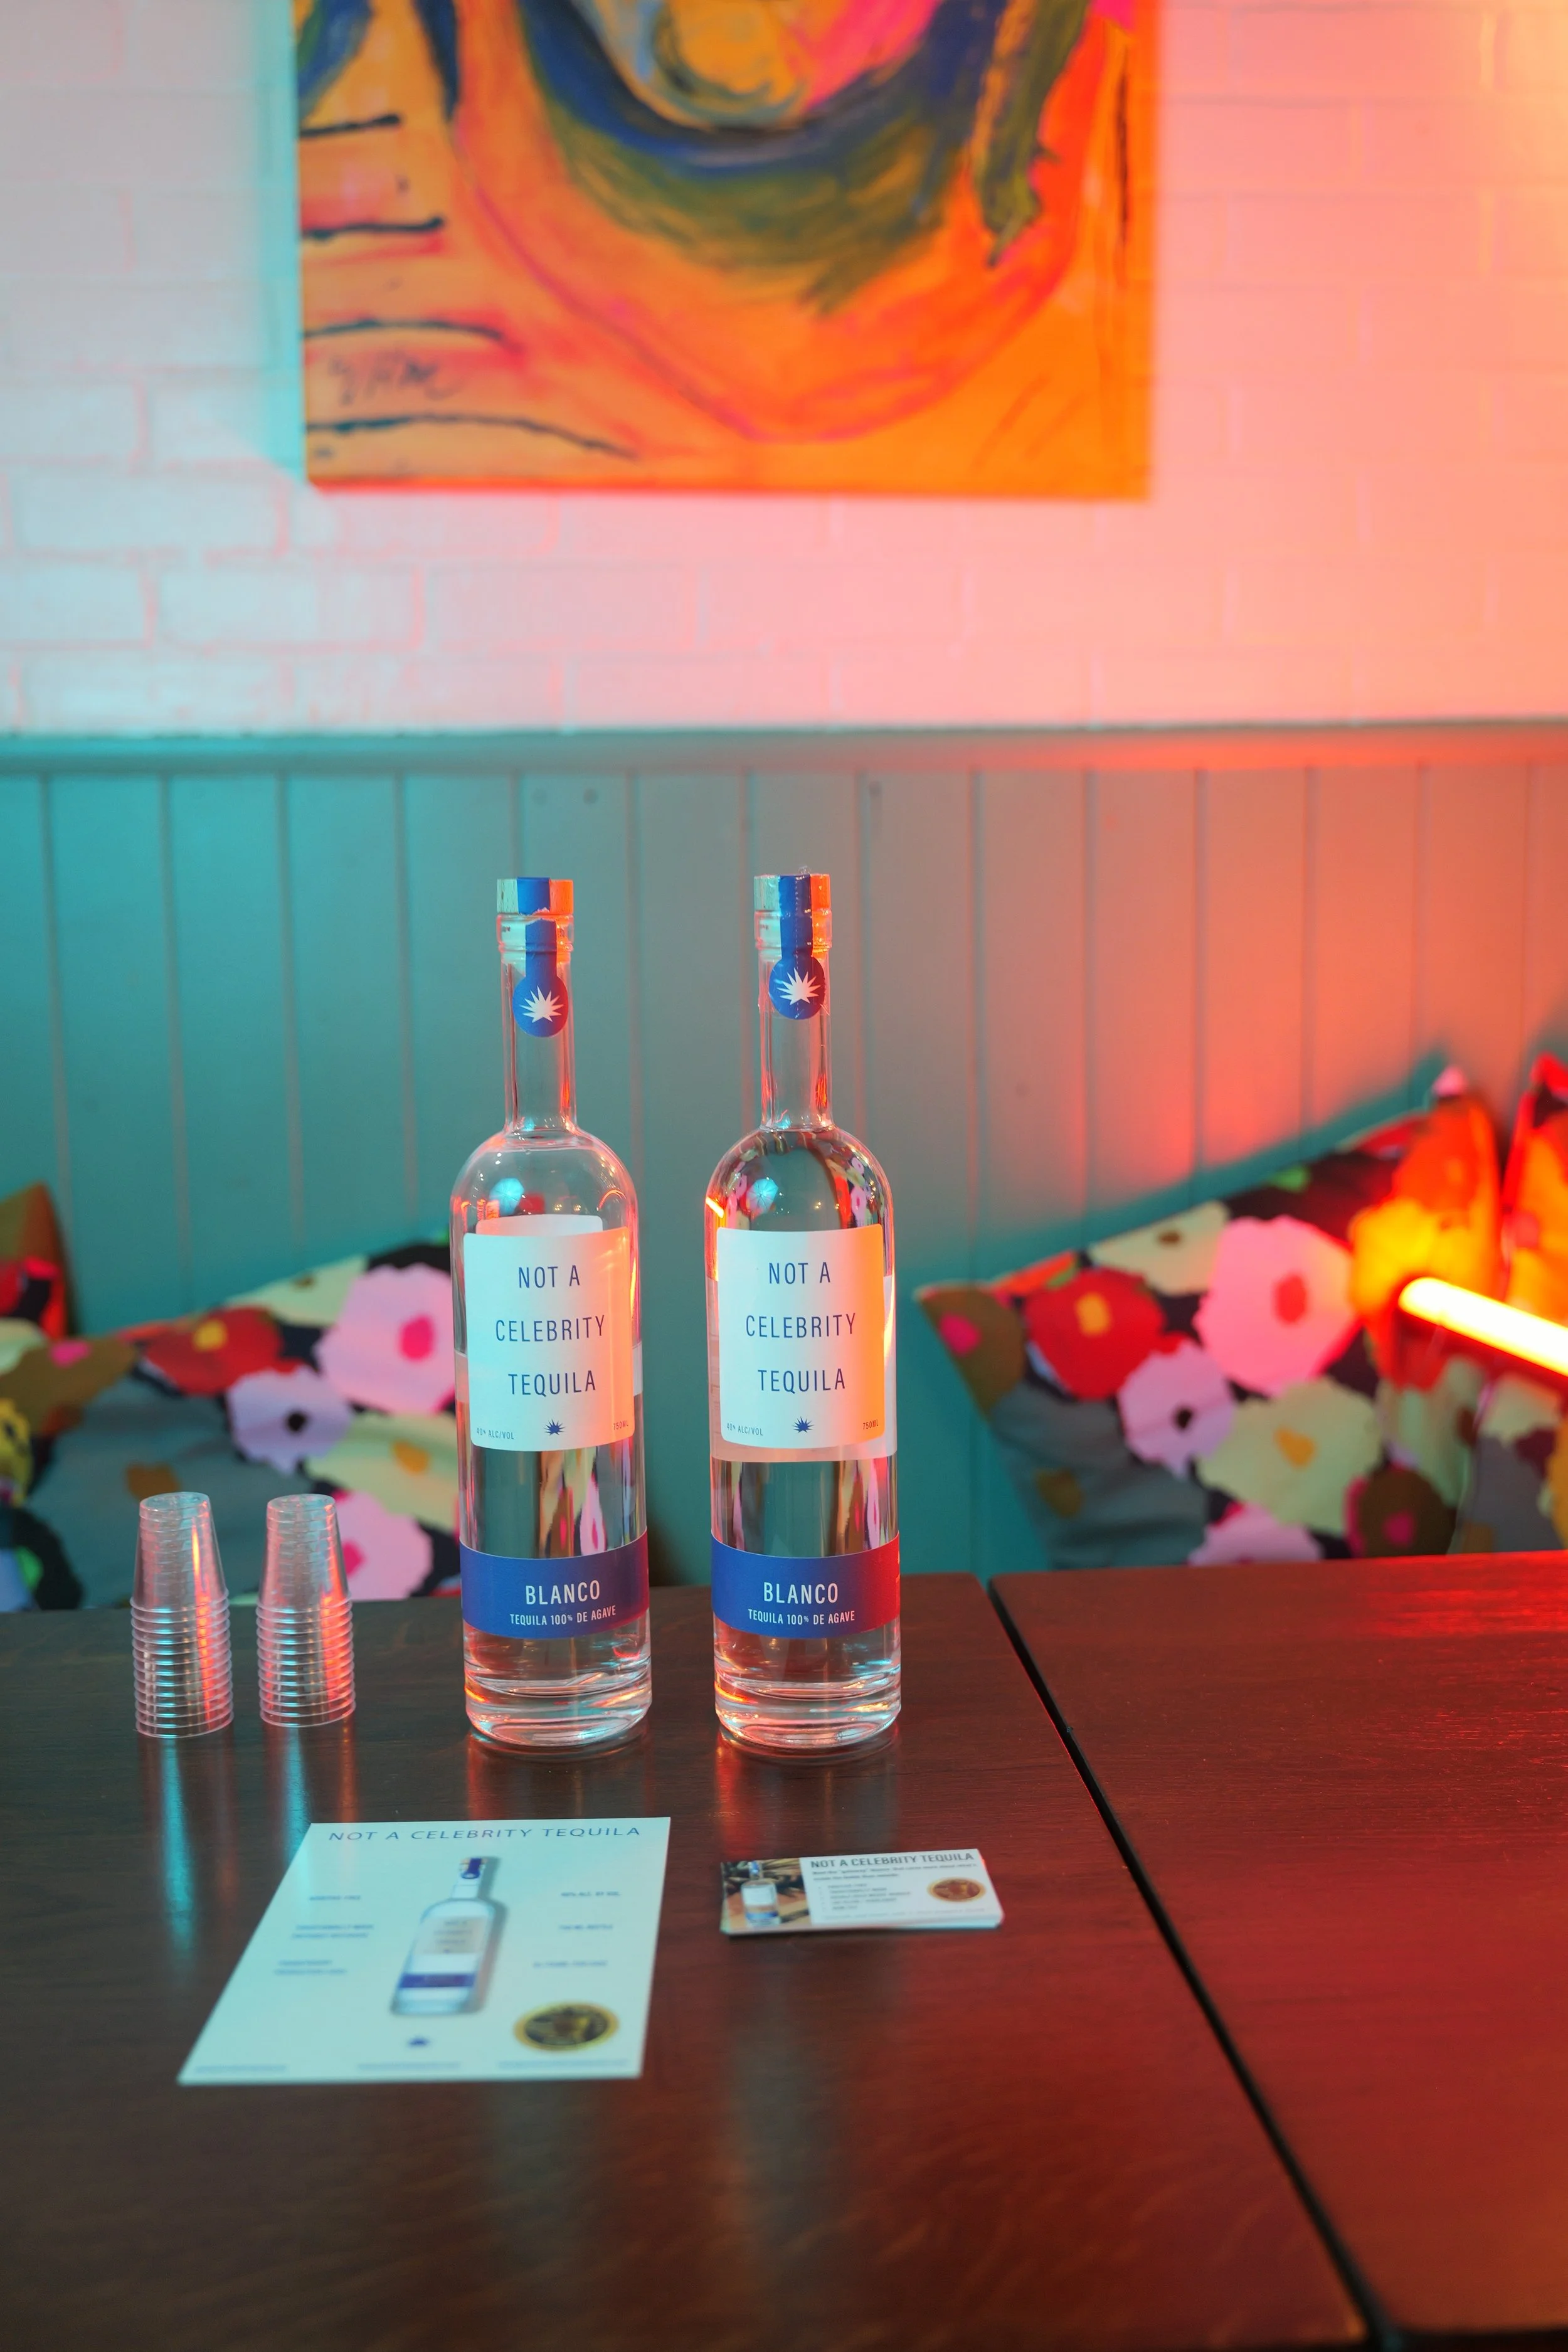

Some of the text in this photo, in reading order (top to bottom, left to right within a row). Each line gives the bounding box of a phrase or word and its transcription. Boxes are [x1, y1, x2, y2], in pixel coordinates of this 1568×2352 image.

[519, 1264, 581, 1288] NOT A
[768, 1261, 831, 1285] NOT A
[495, 1315, 605, 1342] CELEBRITY
[746, 1312, 856, 1338] CELEBRITY
[507, 1370, 596, 1397] TEQUILA
[757, 1368, 845, 1394] TEQUILA
[488, 1429, 515, 1440] ALC/VOL
[613, 1419, 629, 1431] 750ML
[738, 1425, 763, 1436] ALC/VOL
[862, 1418, 879, 1430] 750ML
[525, 1579, 601, 1606] BLANCO
[763, 1581, 839, 1604] BLANCO
[509, 1604, 617, 1626] TEQUILA 100% DE AGAVE
[748, 1608, 856, 1626] TEQUILA 100% DE AGAVE
[328, 1826, 640, 1841] NOT A CELEBRITY TEQUILA
[810, 1852, 975, 1868] NOT A CELEBRITY TEQUILA
